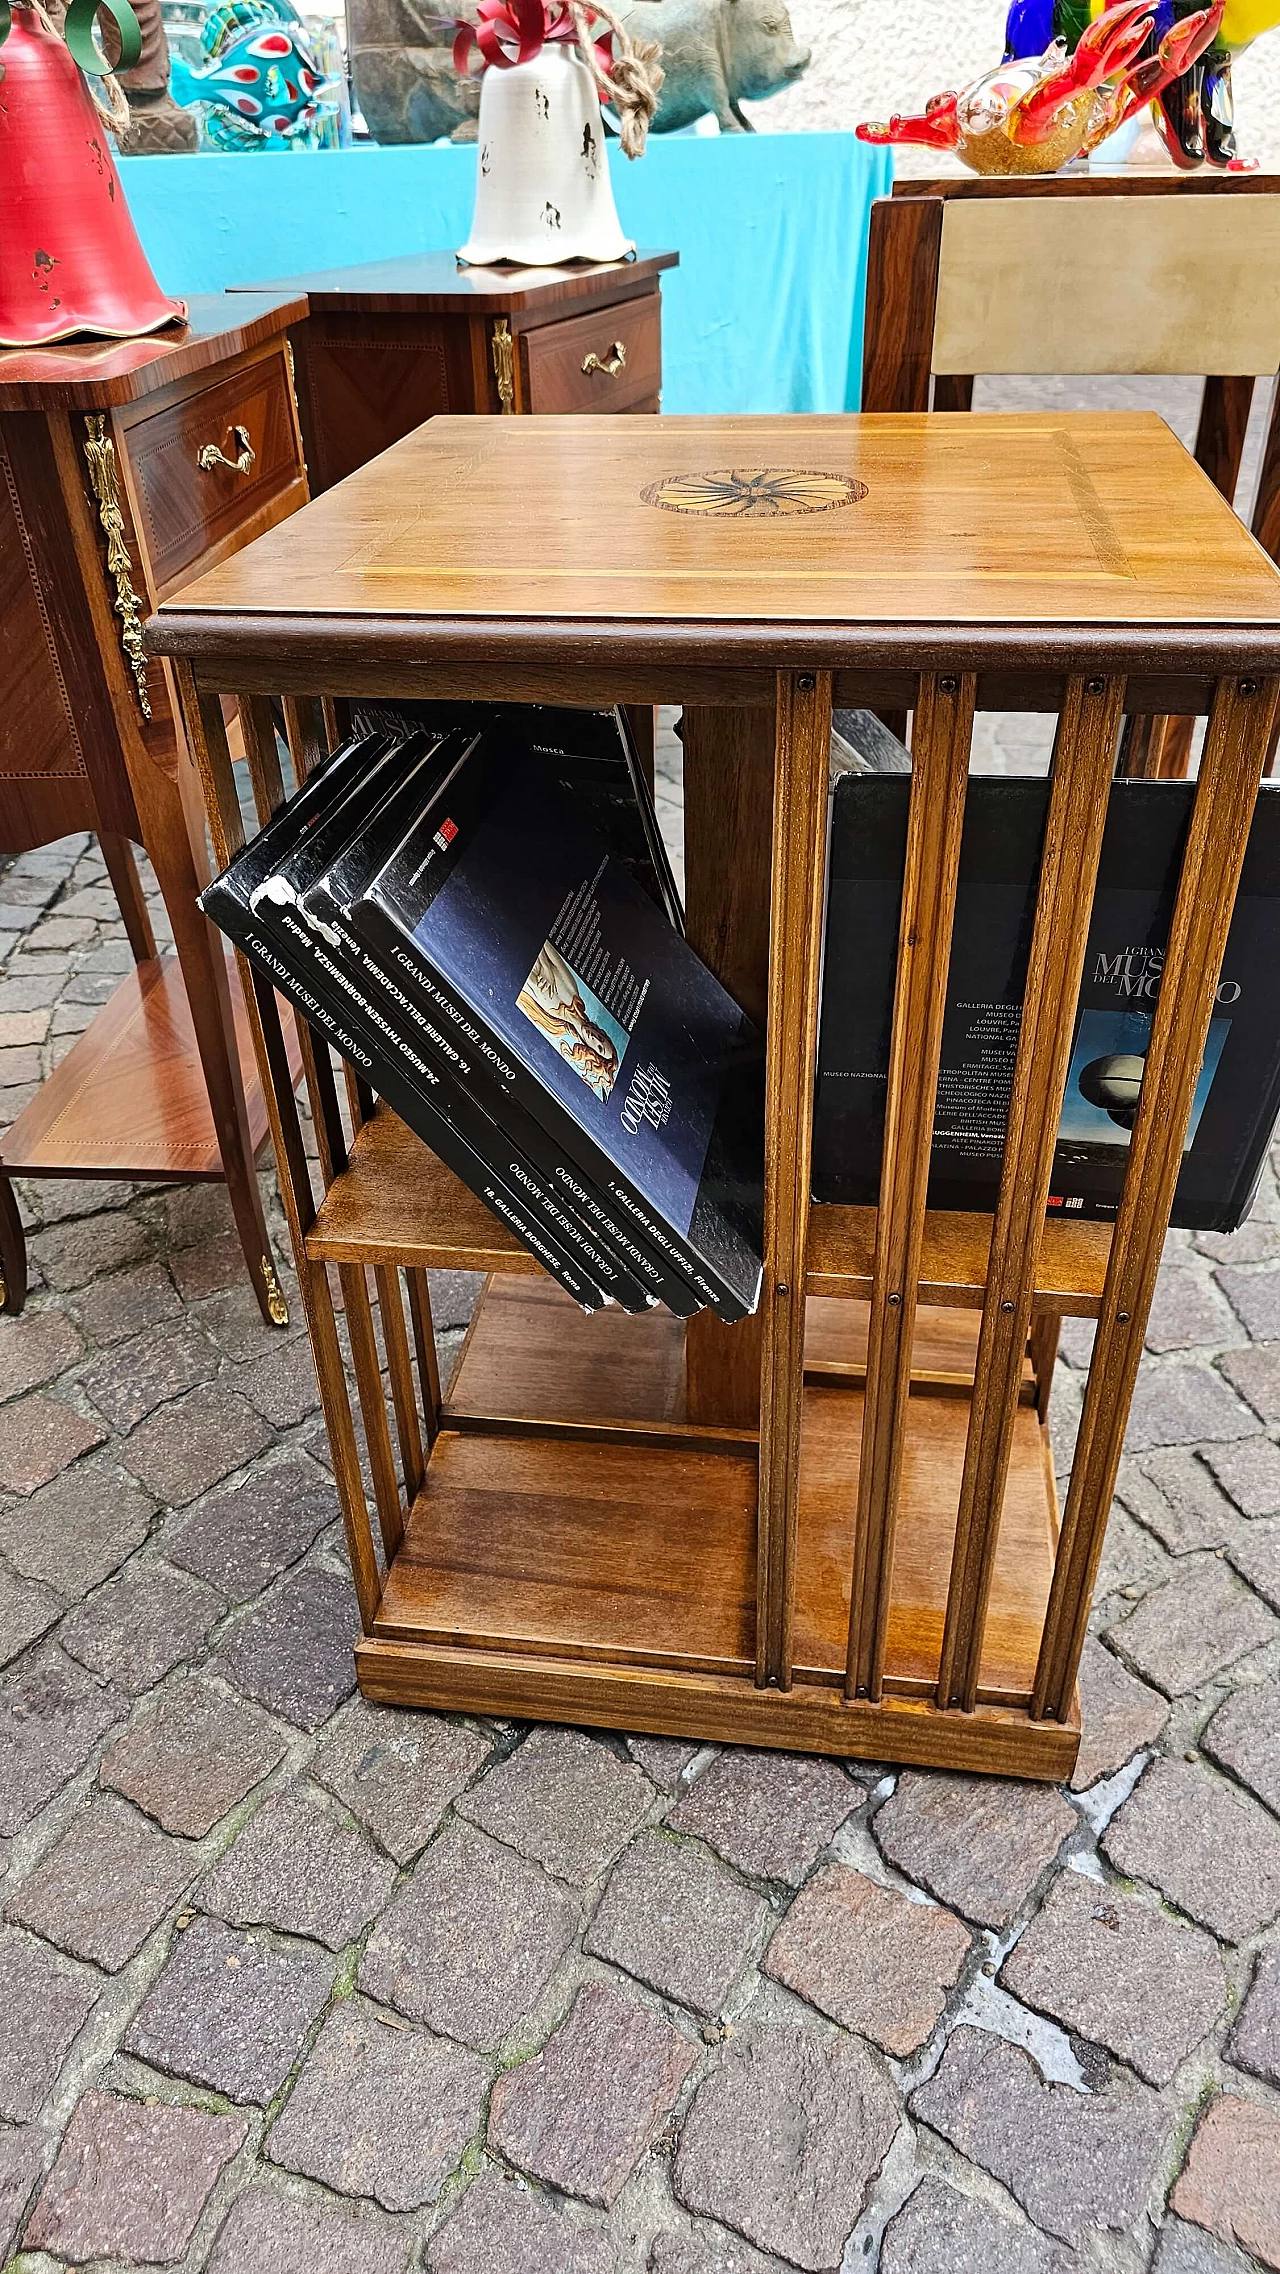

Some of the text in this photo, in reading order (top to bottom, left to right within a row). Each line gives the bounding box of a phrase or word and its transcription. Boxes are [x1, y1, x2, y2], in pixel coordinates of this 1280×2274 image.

[532, 744, 564, 754] Mosca
[281, 915, 314, 948] Madrid
[1092, 952, 1166, 978] MUS
[1125, 946, 1166, 956] I GRAN
[1094, 975, 1118, 984] DEL
[1115, 974, 1242, 1004] MOO
[244, 932, 373, 1067] I GRANDI MUSEI DEL MONDO
[313, 946, 402, 1045] THYSSEN-BORNEMISZA,
[324, 920, 471, 1074] 16. GALLERIE DELL'ACCADEMIA, Venezia
[956, 1002, 994, 1010] GALLERIA
[389, 945, 516, 1080] I GRANDI MUSEI DEL MONDO
[976, 1018, 1009, 1026] LOUVRE,
[970, 1026, 1002, 1034] LOUVRE,
[939, 1069, 988, 1077] TROPOLITAN
[939, 1083, 994, 1091] THISTORISCHES
[620, 1062, 652, 1134] MONDO
[642, 1066, 672, 1130] MUSEI
[938, 1090, 988, 1098] CHEOLOGICO
[932, 1130, 980, 1138] UGGENHEIM,
[951, 1124, 985, 1132] GALLERIA
[509, 1163, 545, 1199] MONDO
[555, 1167, 591, 1203] MONDO
[540, 1196, 561, 1217] DEL
[586, 1200, 607, 1220] DEL
[483, 1186, 581, 1291] 18. GALLERIA BORGHESE, Roma
[555, 1214, 585, 1244] MUSEI
[601, 1218, 631, 1247] MUSEI
[607, 1181, 721, 1303] 1. GALLERIA DEGLI UFFIZI, Firenze
[579, 1241, 613, 1275] GRANDI
[625, 1244, 659, 1278] GRANDI
